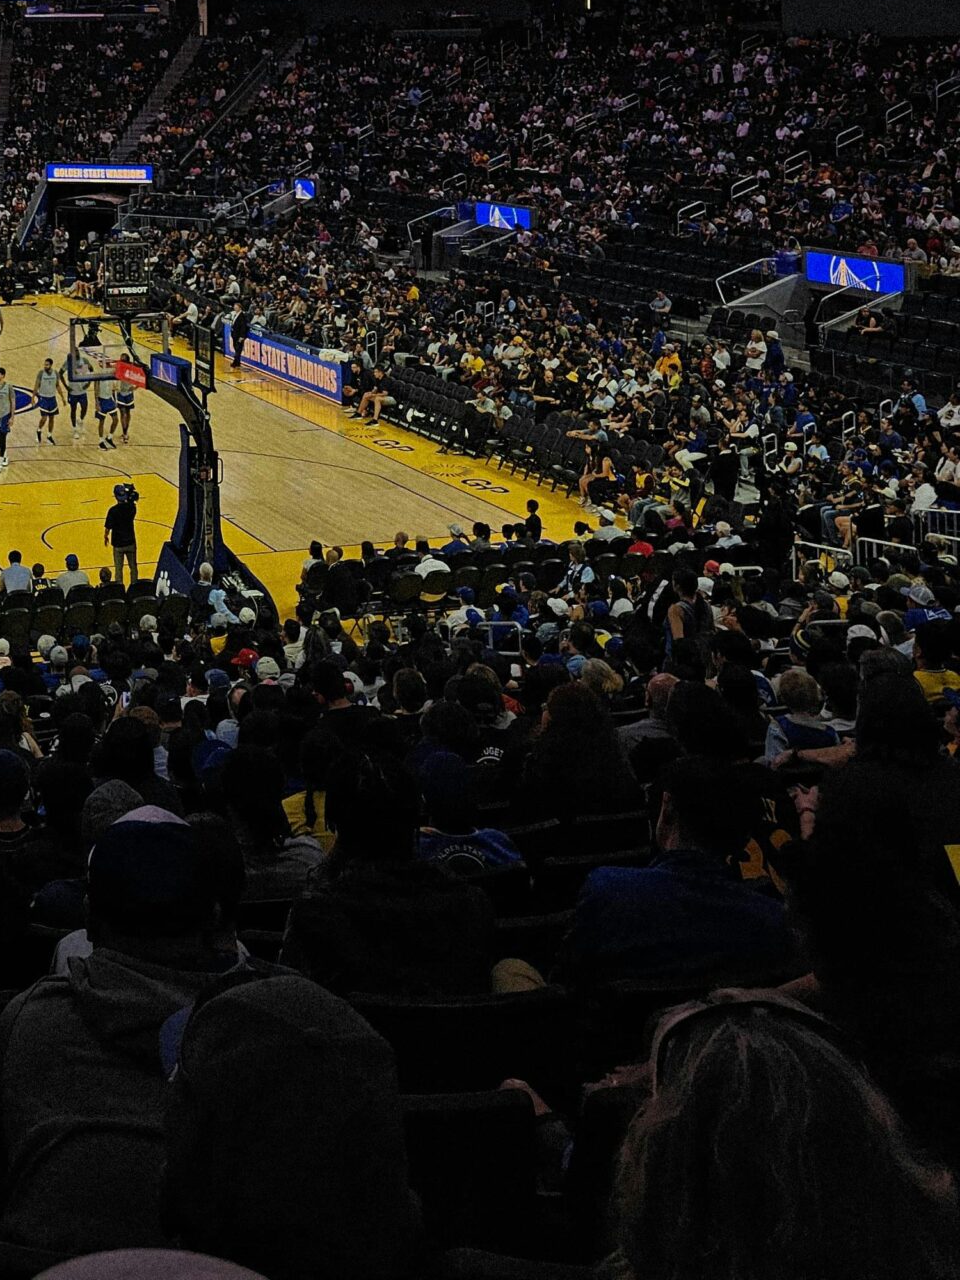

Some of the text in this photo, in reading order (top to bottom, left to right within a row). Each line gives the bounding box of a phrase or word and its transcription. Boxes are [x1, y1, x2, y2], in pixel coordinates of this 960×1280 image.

[120, 286, 148, 294] TISSOT
[261, 343, 287, 374] STATE
[286, 352, 338, 394] WARRIORS
[373, 439, 416, 452] GP
[461, 478, 510, 494] GP
[479, 746, 505, 757] UGET
